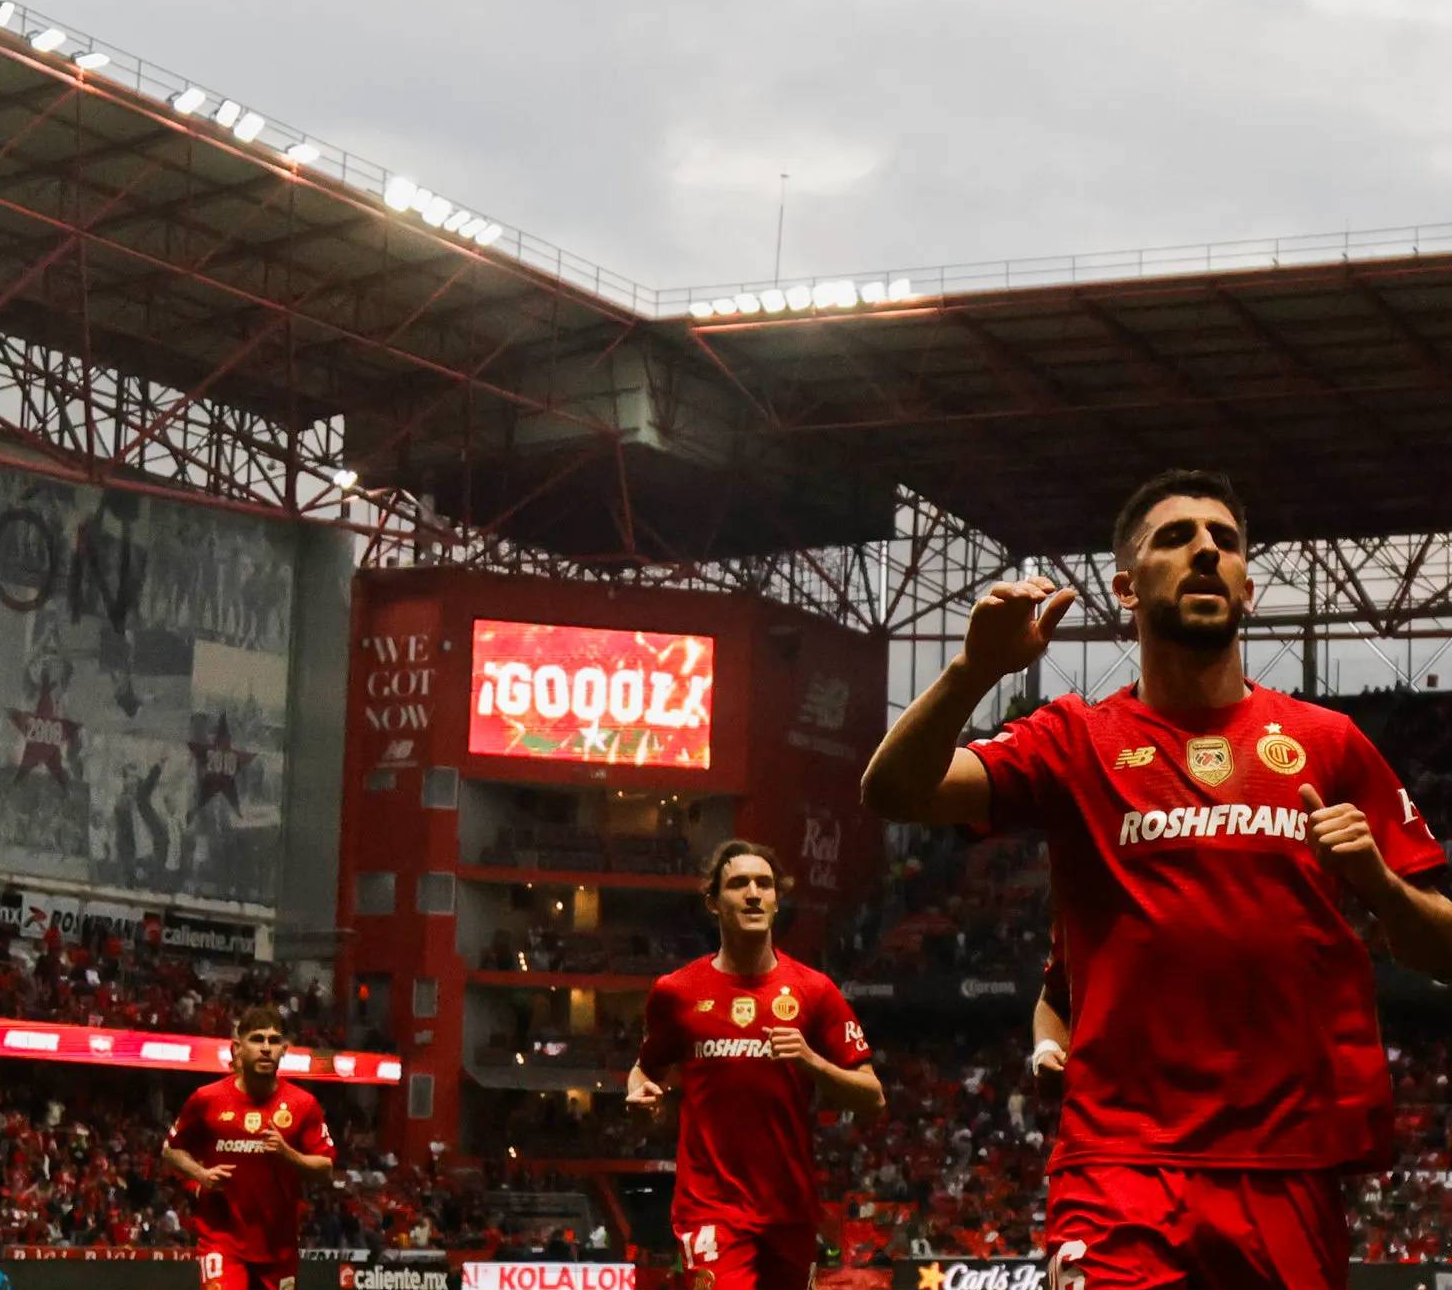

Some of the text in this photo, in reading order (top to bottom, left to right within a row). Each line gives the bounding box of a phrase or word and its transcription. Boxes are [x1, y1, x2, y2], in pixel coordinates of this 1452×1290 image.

[373, 635, 429, 663] WE
[367, 669, 434, 697] GOT
[478, 662, 706, 728] ¡GOOOL!
[365, 701, 434, 730] NOW
[1119, 804, 1308, 846] ROSHFRANS
[695, 1039, 774, 1058] ROSHFRA
[682, 1225, 719, 1269] 14
[355, 1264, 448, 1290] caliente.mx
[499, 1266, 575, 1290] KOLA
